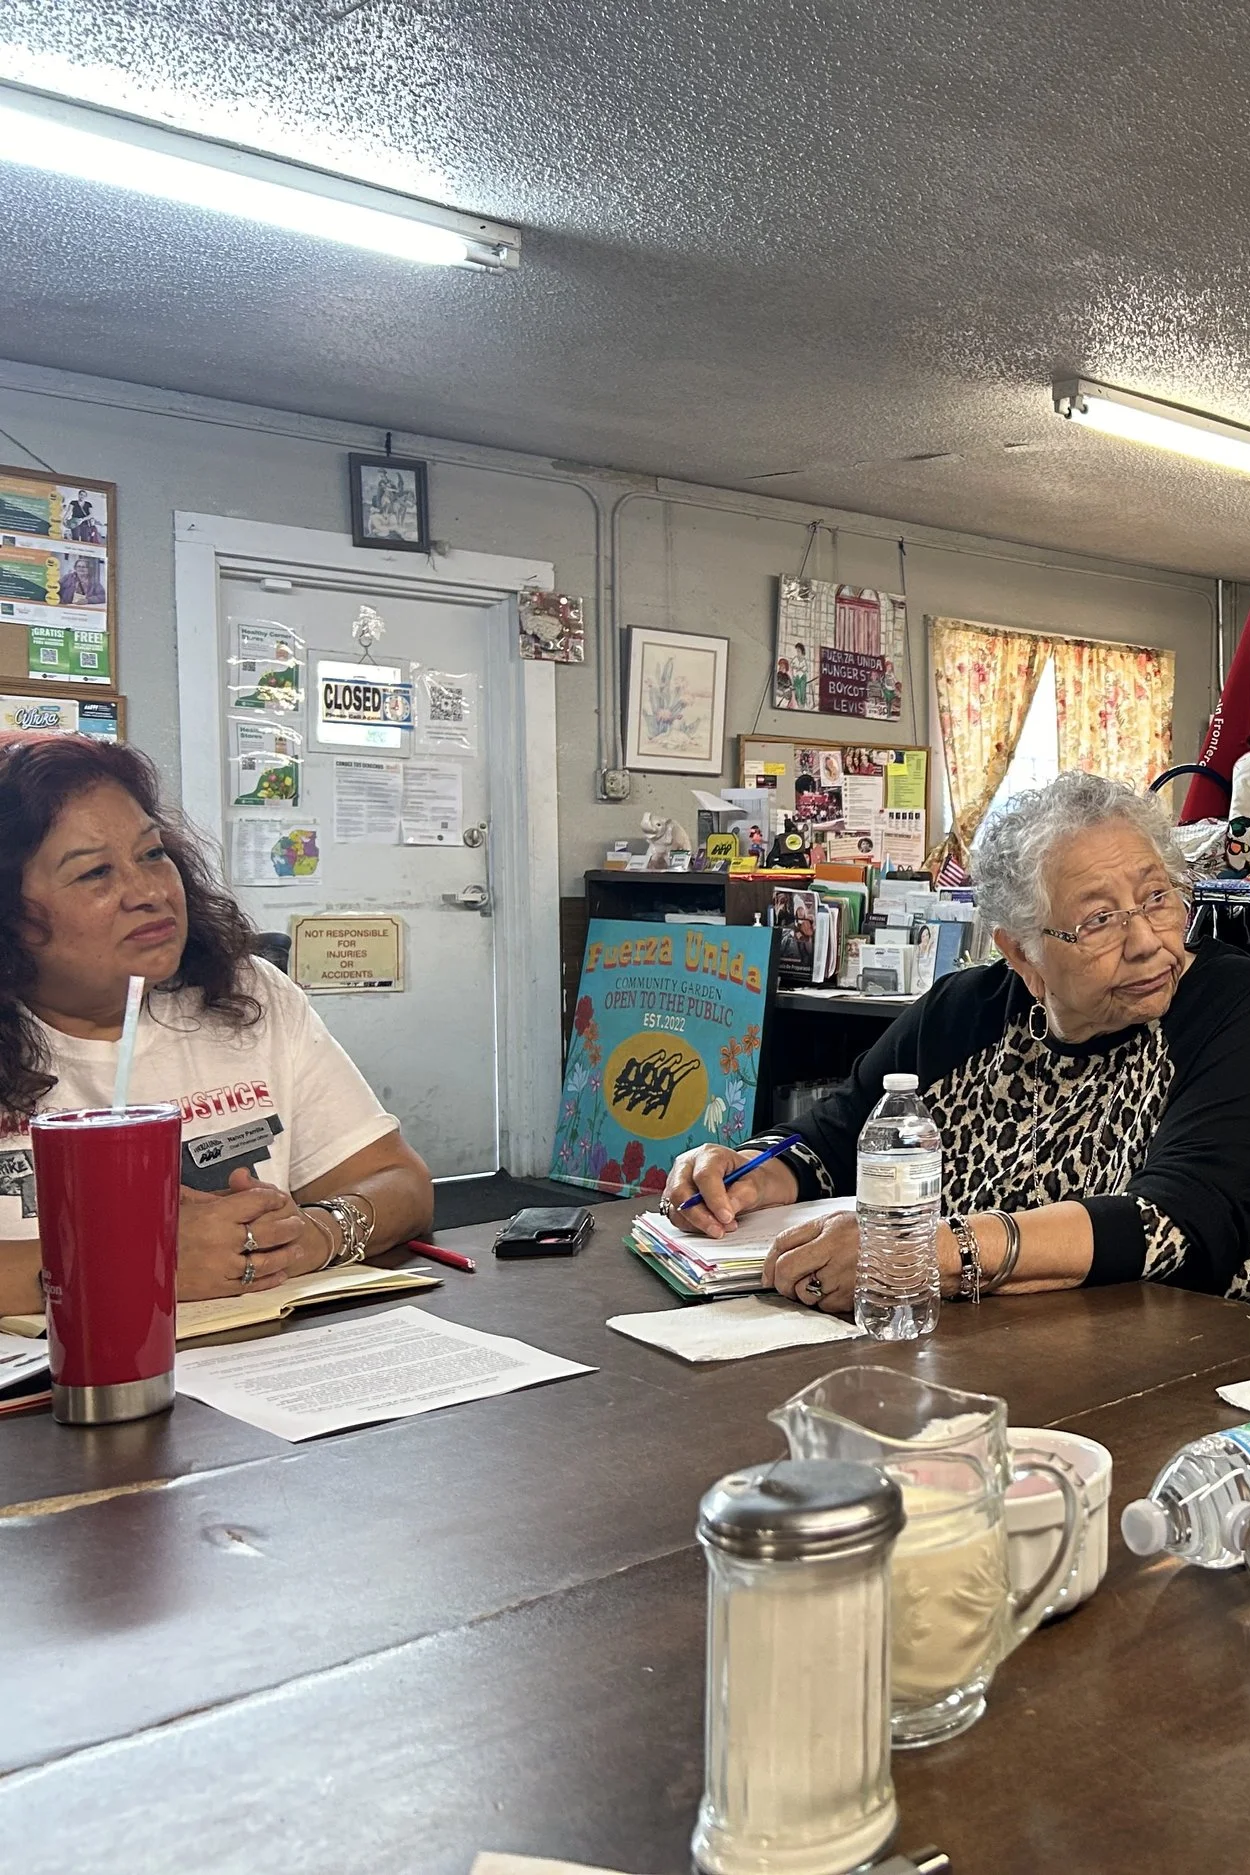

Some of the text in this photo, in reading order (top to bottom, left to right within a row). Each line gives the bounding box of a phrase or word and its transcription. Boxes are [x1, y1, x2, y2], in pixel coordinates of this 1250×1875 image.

[74, 631, 104, 645] FREE!
[821, 649, 883, 671] FUERZA UNIDA
[324, 683, 381, 712] CLOSED
[304, 929, 389, 938] NOT RESPONSIBLE
[337, 939, 356, 948] FOR
[326, 950, 368, 959] INJURIES
[339, 960, 354, 969] OR
[585, 928, 762, 995] Fuerza Unida
[321, 970, 374, 980] ACCIDENTS
[615, 976, 723, 1001] COMMUNITY GARDEN
[604, 990, 734, 1028] OPEN TO THE PUBLIC
[643, 1012, 687, 1033] EST.2022
[174, 1080, 274, 1124] USTICE
